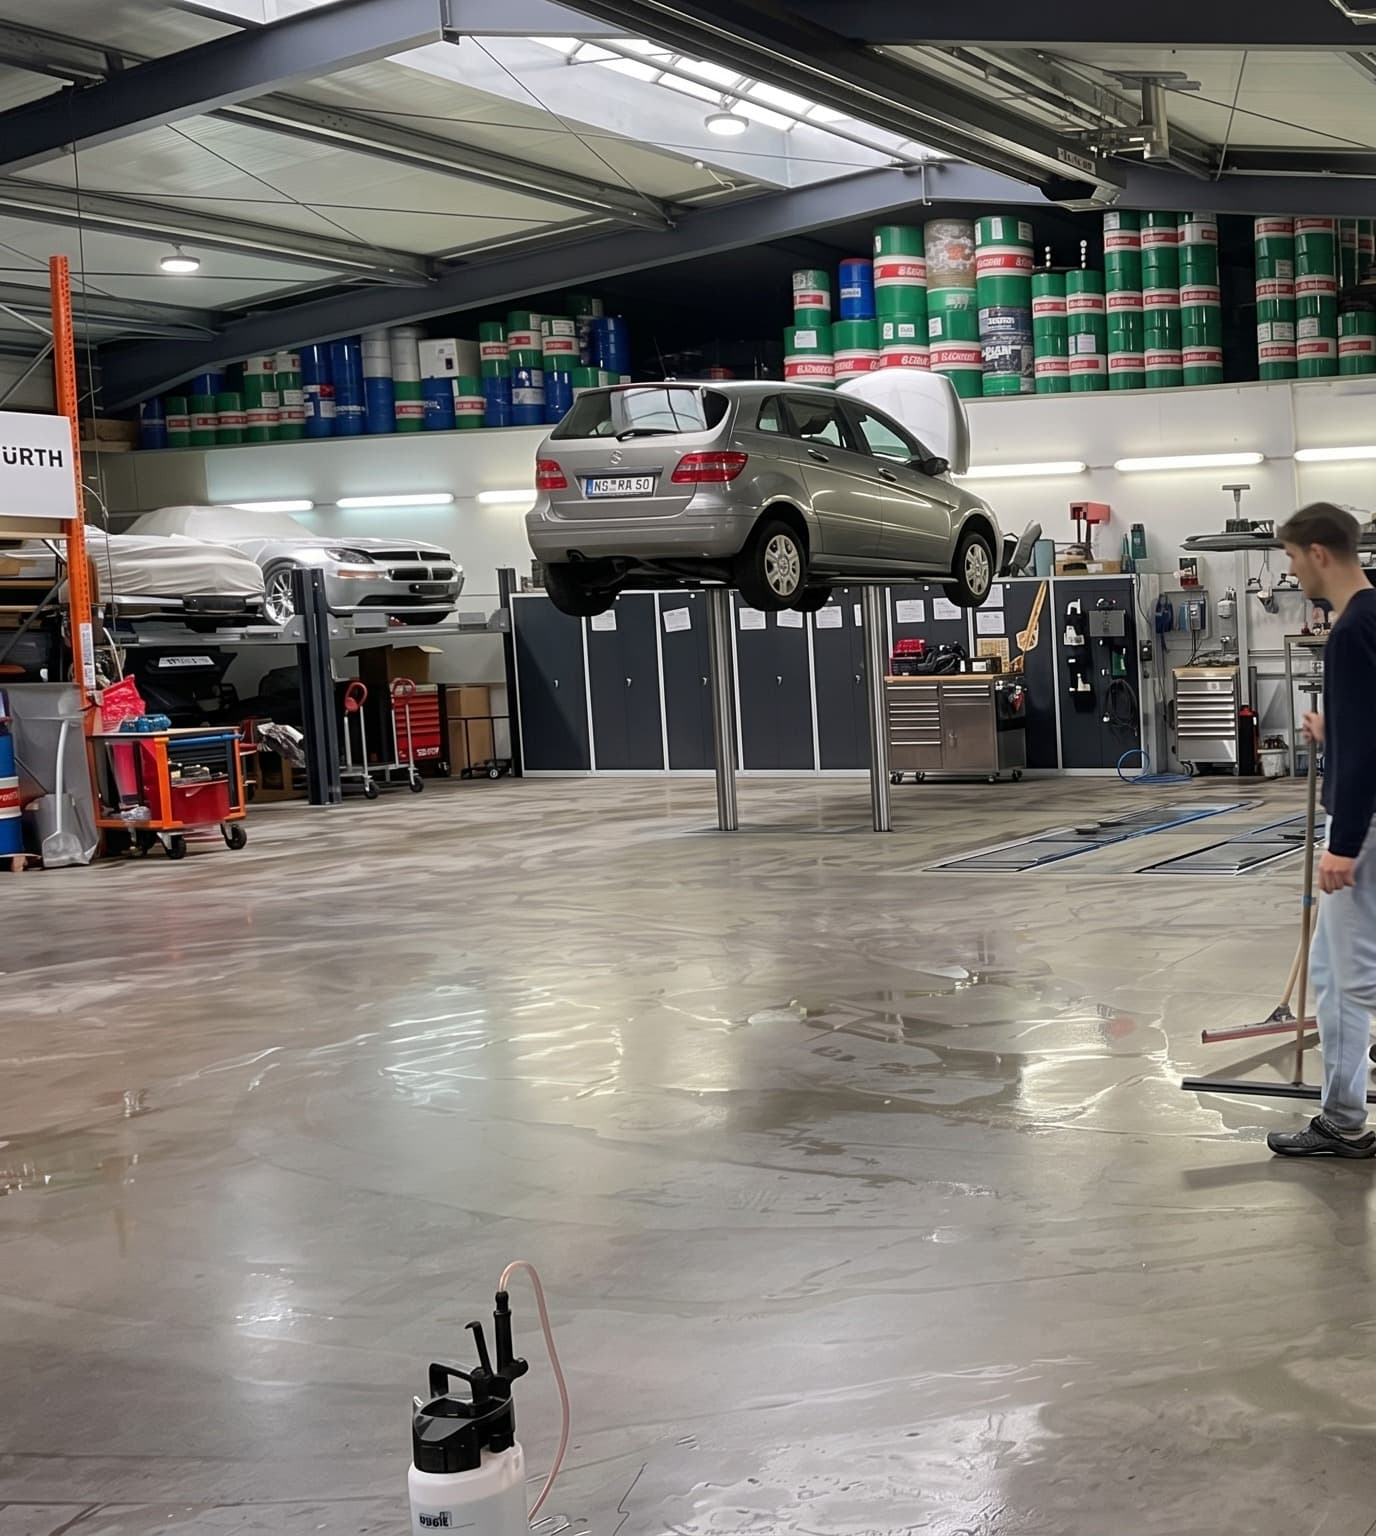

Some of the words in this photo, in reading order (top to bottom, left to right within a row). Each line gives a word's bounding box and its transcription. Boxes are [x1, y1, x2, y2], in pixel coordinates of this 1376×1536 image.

[594, 480, 609, 492] NS
[617, 479, 632, 491] RA
[635, 478, 650, 490] 50
